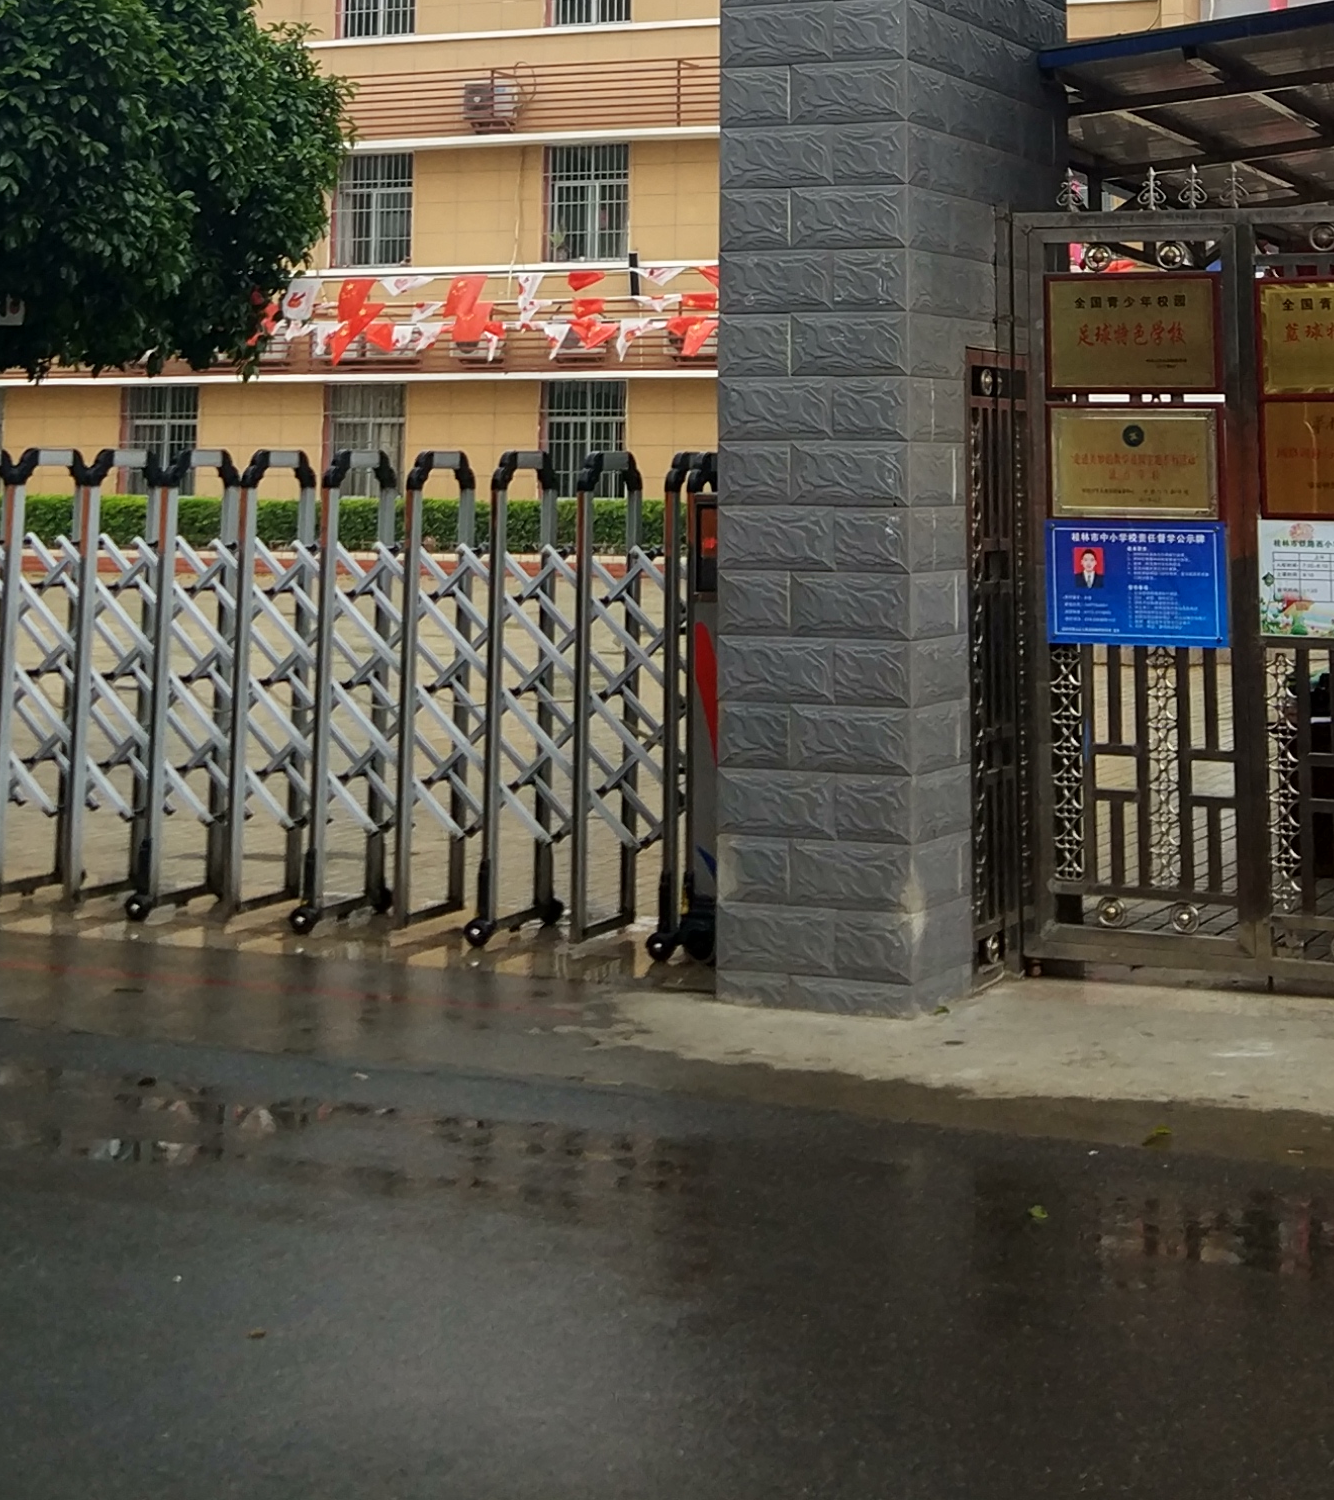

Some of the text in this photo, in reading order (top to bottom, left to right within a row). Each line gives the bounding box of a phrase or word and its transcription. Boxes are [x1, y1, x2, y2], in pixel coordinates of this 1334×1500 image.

[1074, 294, 1186, 309] 全国青少年校园
[1077, 319, 1187, 347] 足球特色学校
[1071, 533, 1206, 544] 桂林市中小学校责任督学公示牌
